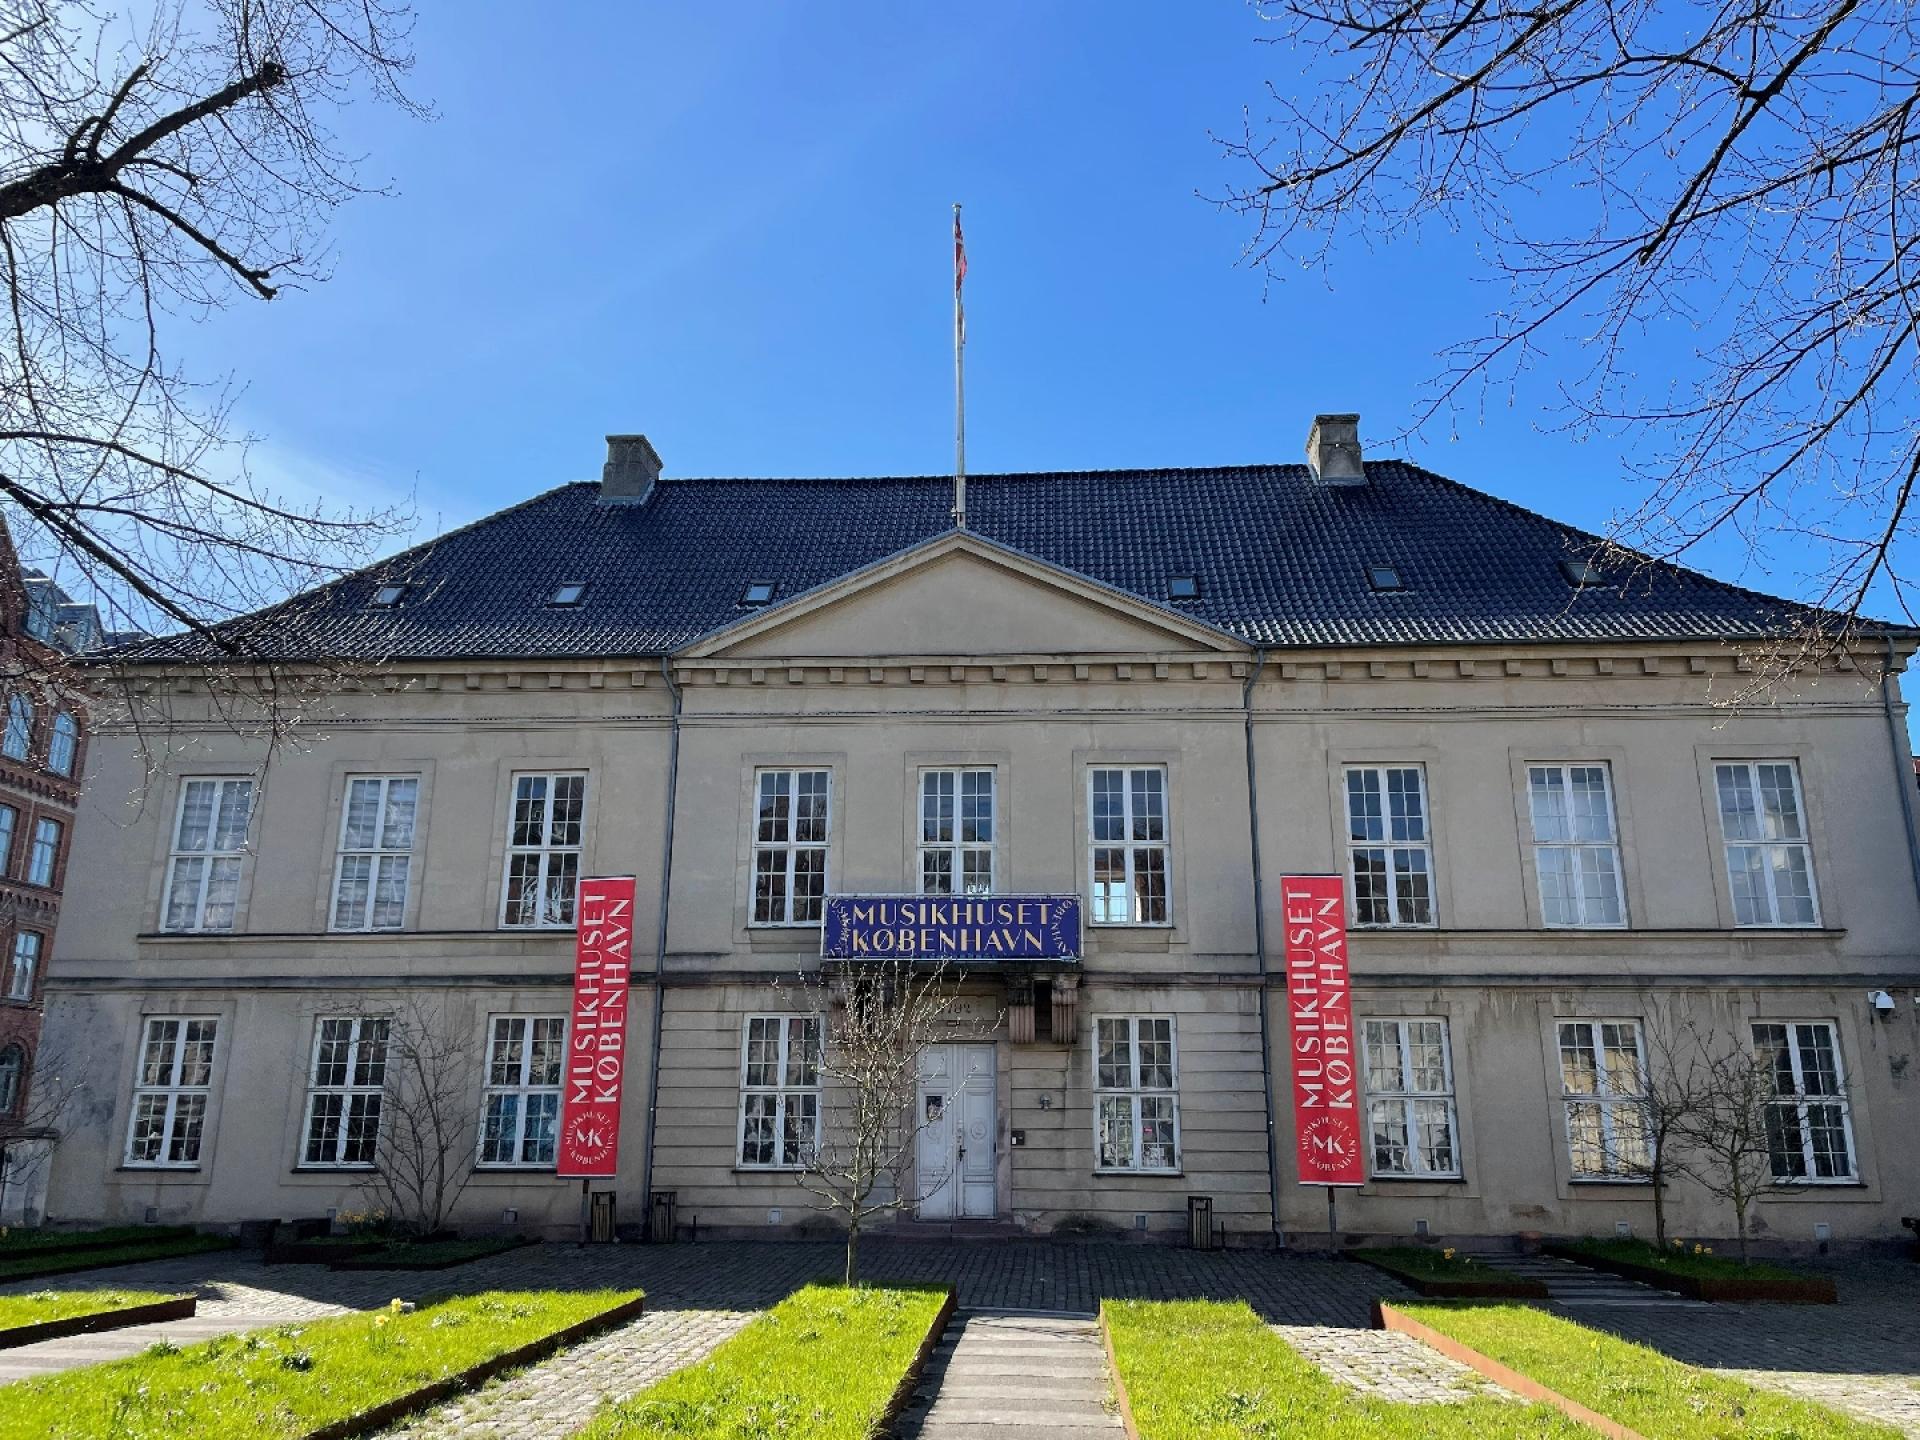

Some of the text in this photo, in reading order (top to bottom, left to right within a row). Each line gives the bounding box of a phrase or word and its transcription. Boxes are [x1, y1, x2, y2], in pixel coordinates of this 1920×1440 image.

[852, 903, 1053, 926] MUSIKHUSET
[852, 928, 1042, 951] KØBENHAVN
[570, 890, 605, 1104] MUSIKHUSET
[594, 899, 631, 1104] KØBENHAVN
[1286, 886, 1326, 1109] MUSIKHUSET
[1315, 897, 1353, 1109] KØBENHAVN
[565, 1111, 611, 1145] MUSIKHUSET
[575, 1128, 605, 1148] MK
[1301, 1116, 1350, 1150] MUSIKHUSET
[1312, 1134, 1345, 1155] MK
